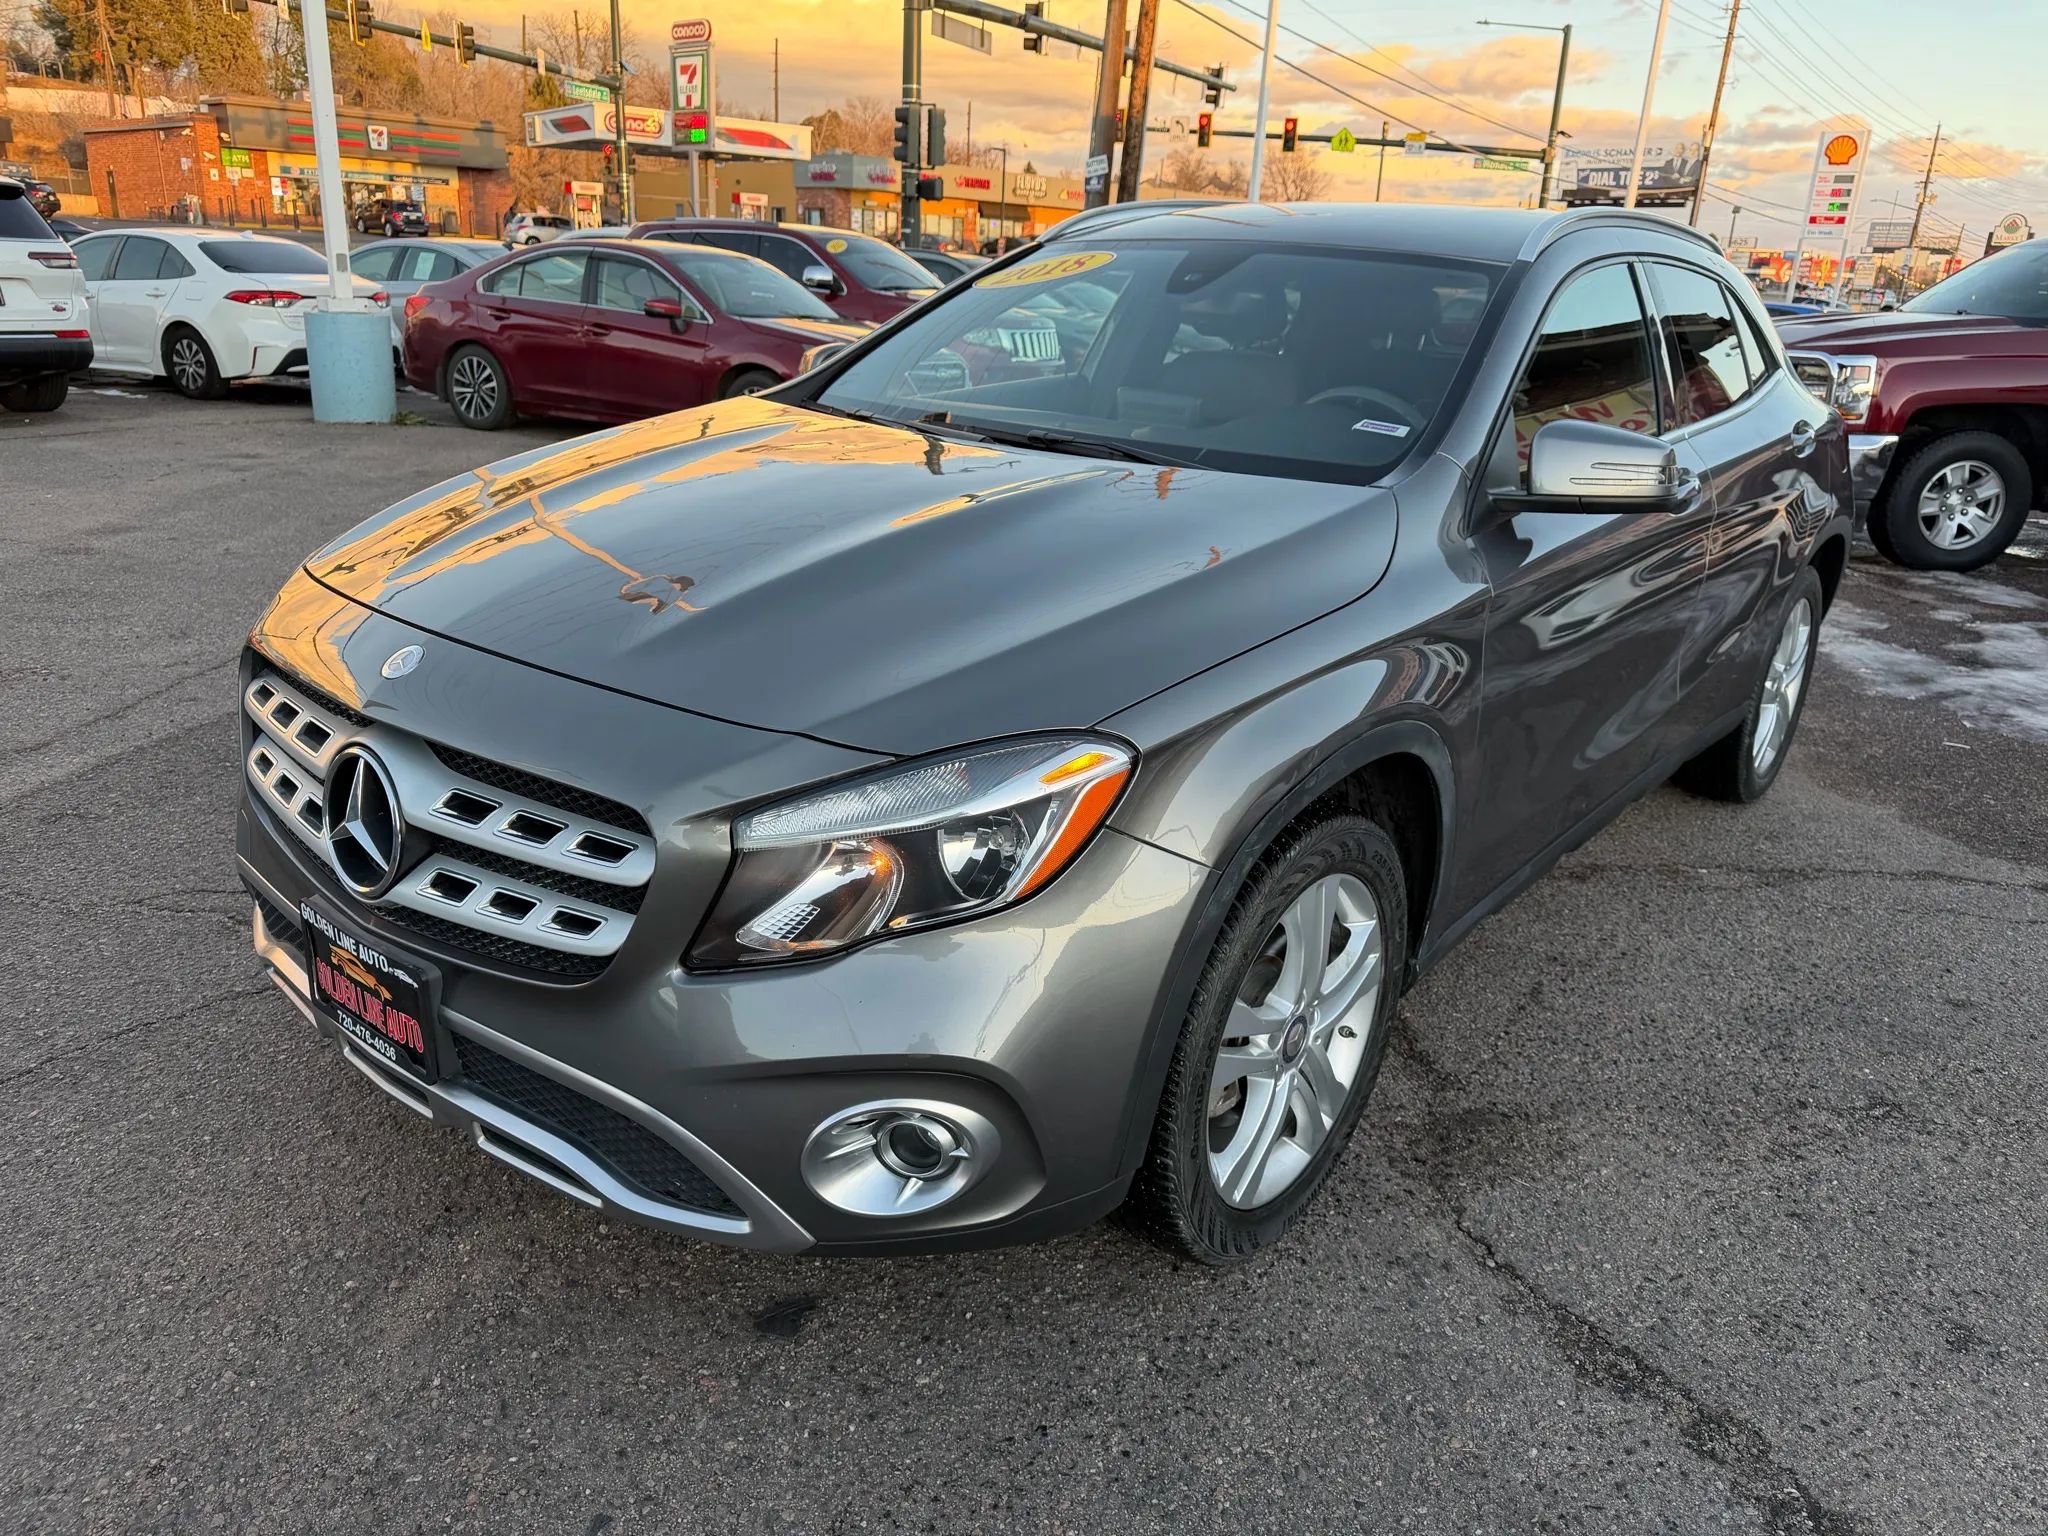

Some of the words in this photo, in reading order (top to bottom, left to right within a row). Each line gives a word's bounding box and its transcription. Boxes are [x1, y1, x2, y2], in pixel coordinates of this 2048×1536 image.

[232, 154, 249, 164] ATM
[1588, 171, 1617, 187] DIAL
[991, 254, 1097, 286] 2018
[300, 902, 335, 940] GOLDEN
[334, 929, 357, 957] LINE
[359, 944, 388, 973] AUTO
[316, 956, 359, 1014] GOLDEN
[357, 988, 386, 1034] LINE
[386, 1004, 424, 1053] AUTO
[337, 1009, 397, 1062] 720-476-4036
